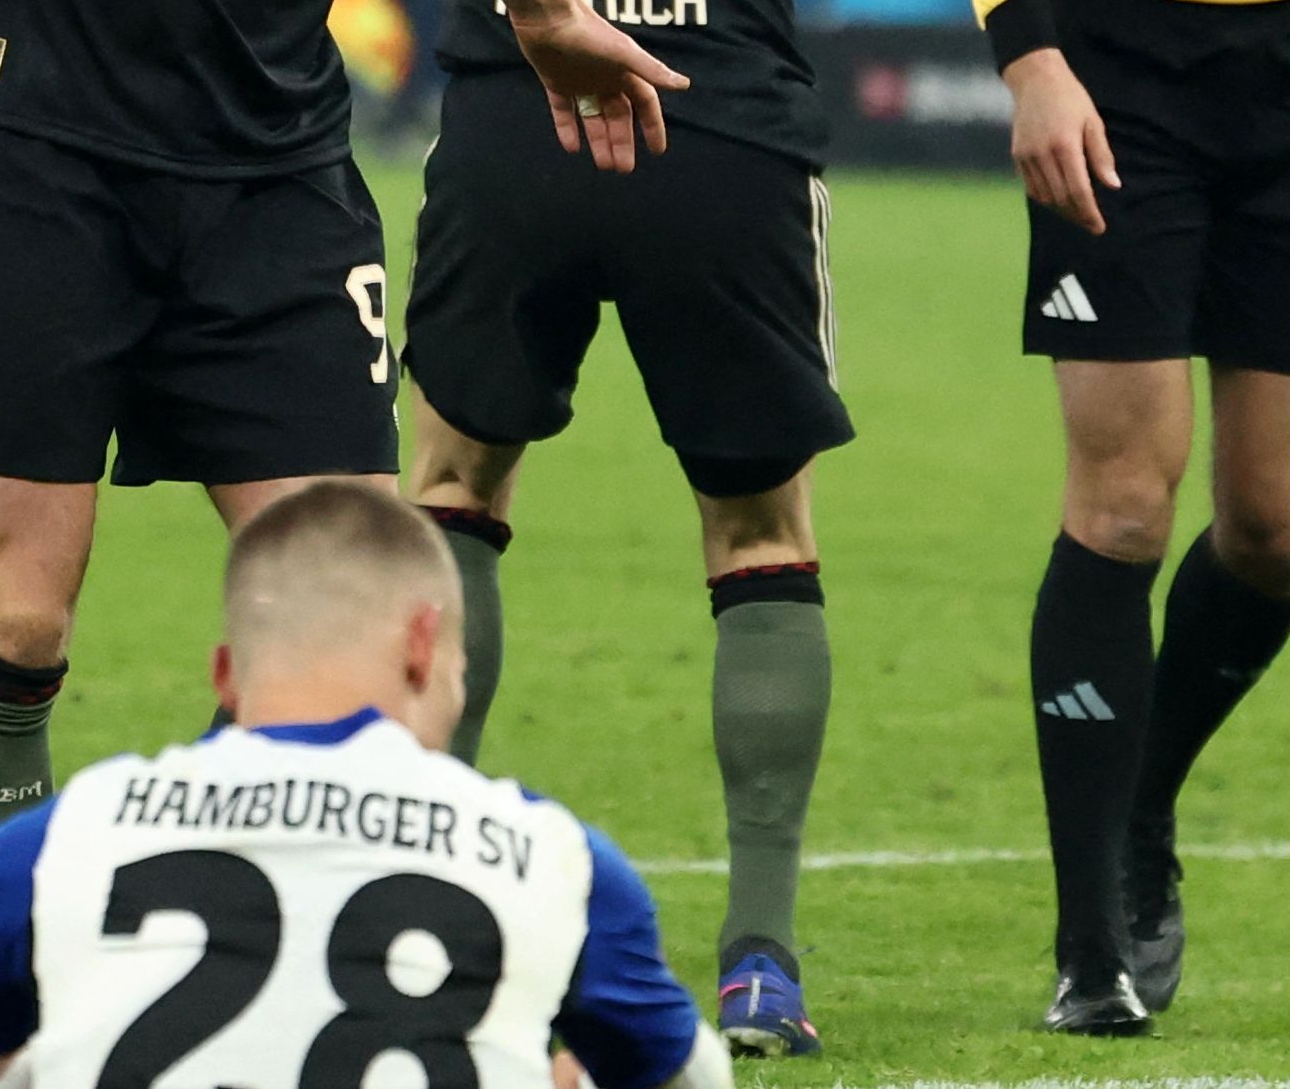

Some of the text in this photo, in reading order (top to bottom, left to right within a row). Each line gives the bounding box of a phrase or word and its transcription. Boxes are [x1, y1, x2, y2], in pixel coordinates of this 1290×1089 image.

[344, 263, 388, 383] 9
[113, 776, 534, 883] HAMBURGER SV
[94, 849, 503, 1089] 28
